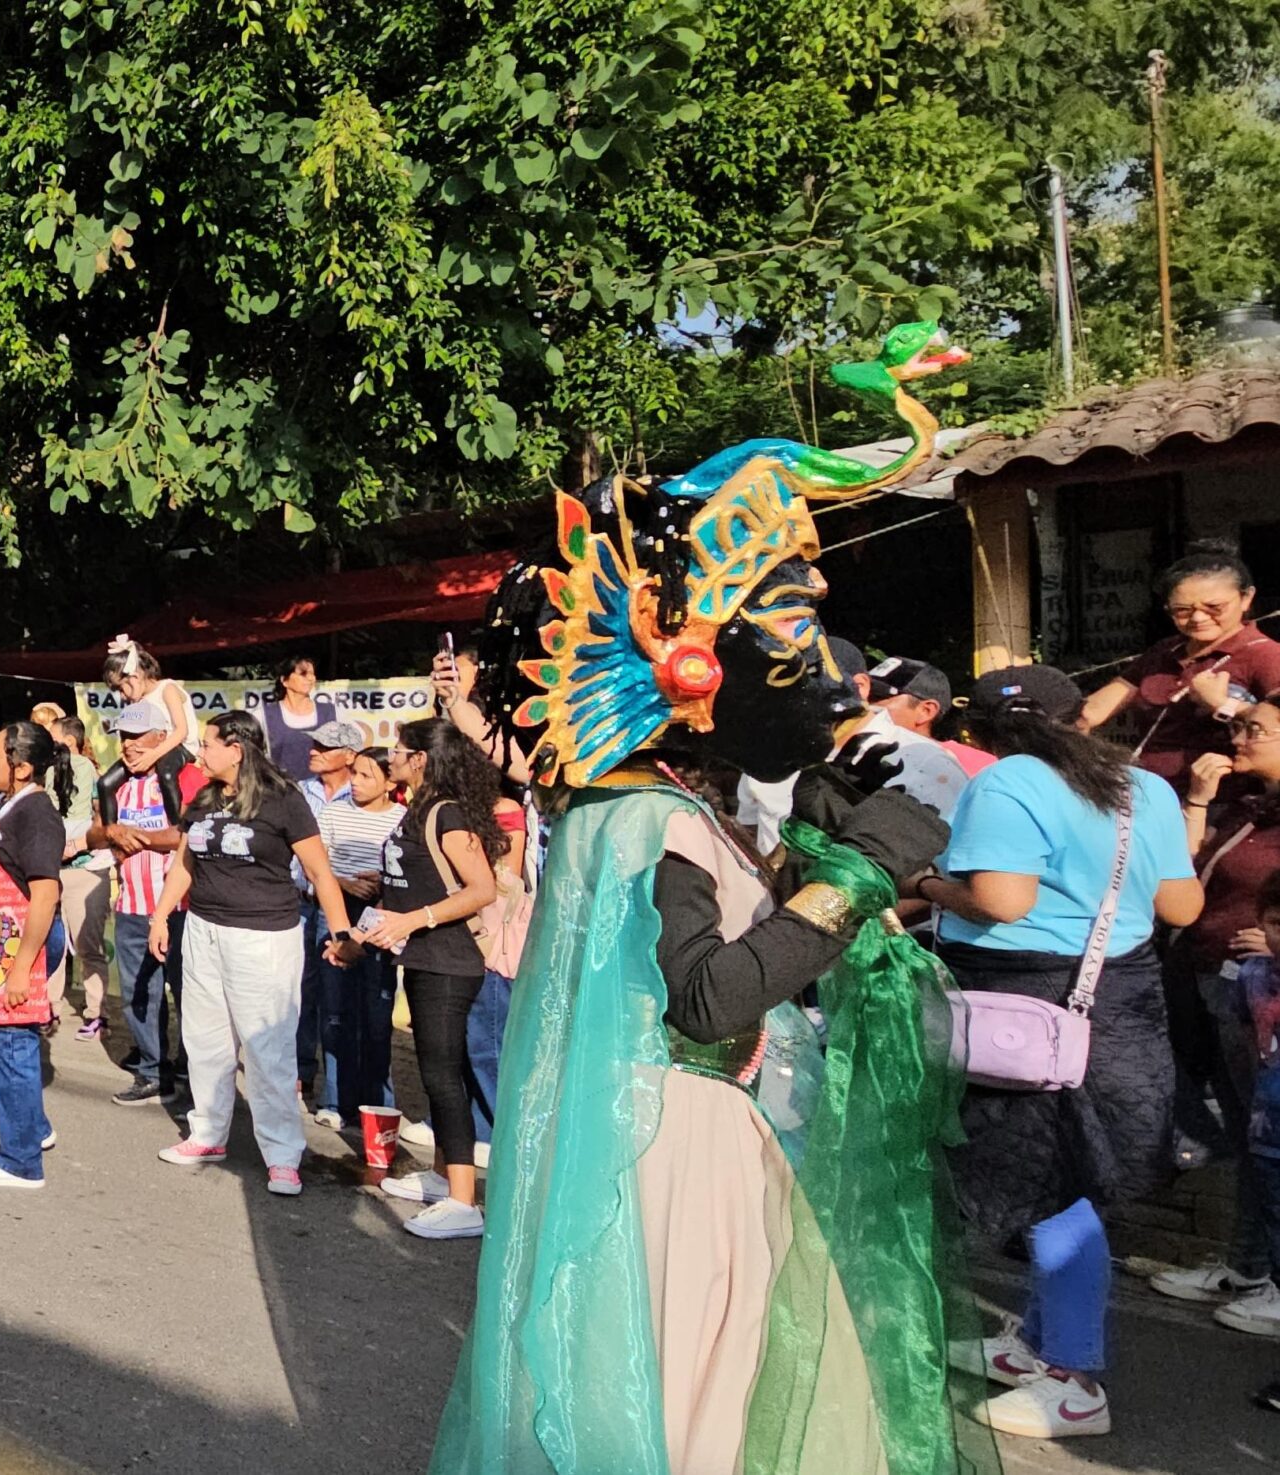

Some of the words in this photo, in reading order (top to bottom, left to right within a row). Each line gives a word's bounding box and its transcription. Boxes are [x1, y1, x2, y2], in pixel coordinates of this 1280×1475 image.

[313, 690, 428, 710] ORREGO
[1111, 837, 1129, 891] BIMBA
[1092, 911, 1113, 951] LOLA
